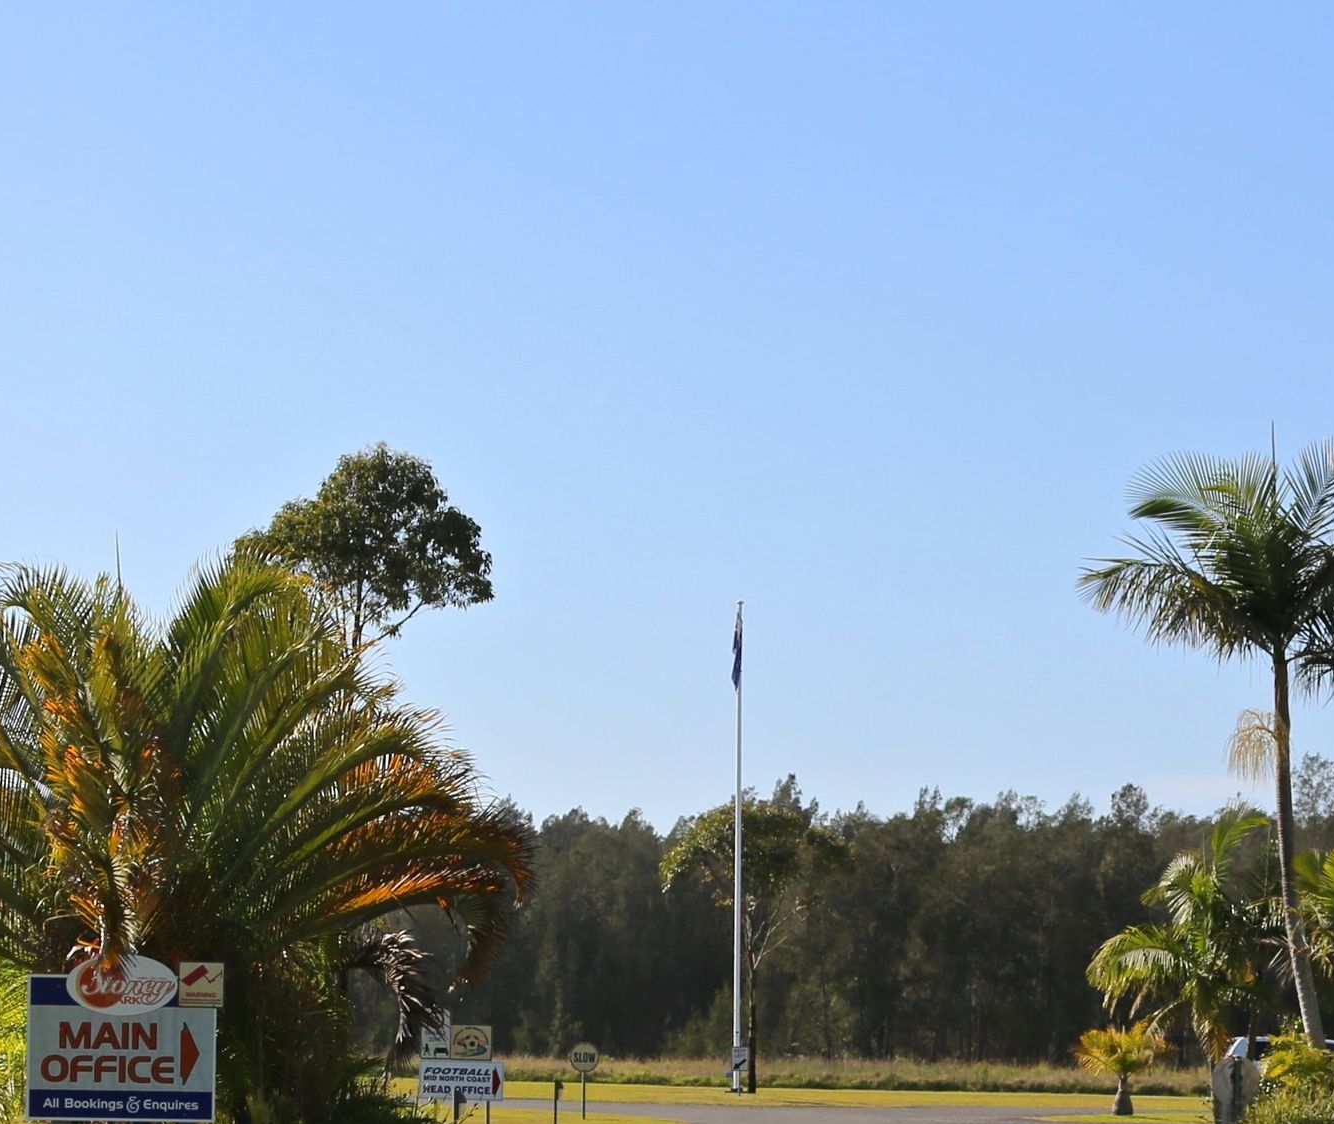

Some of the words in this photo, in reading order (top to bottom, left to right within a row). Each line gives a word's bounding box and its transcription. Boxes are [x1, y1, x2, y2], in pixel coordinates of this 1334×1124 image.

[58, 1021, 158, 1050] MAIN
[573, 1051, 596, 1063] SLOW
[40, 1054, 175, 1085] OFFICE
[424, 1066, 492, 1076] FOOTBALL
[423, 1084, 451, 1094] HEAD
[43, 1097, 60, 1109] All
[64, 1098, 124, 1112] Bookings
[126, 1096, 141, 1114] &
[142, 1099, 199, 1113] Enquires
